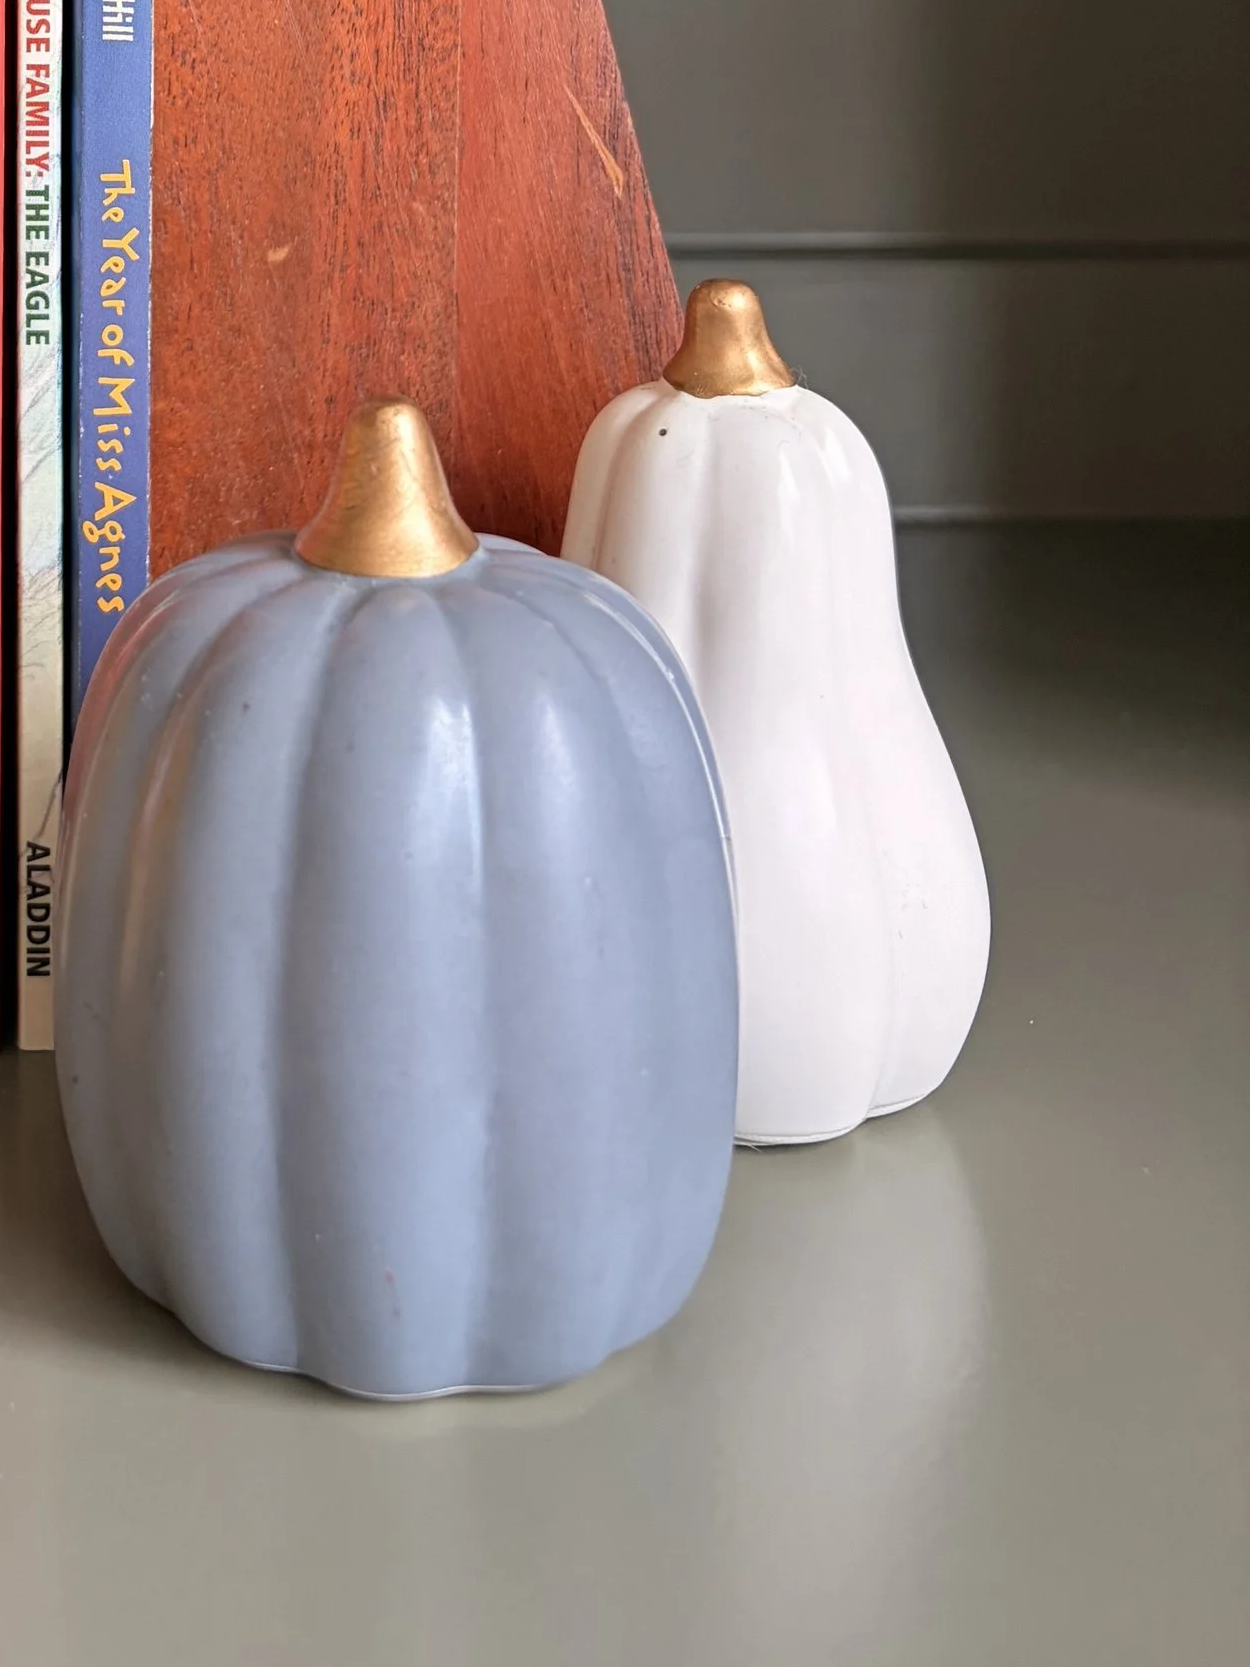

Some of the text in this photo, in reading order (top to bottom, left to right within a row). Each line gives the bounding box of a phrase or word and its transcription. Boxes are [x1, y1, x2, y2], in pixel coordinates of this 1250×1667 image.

[25, 63, 50, 178] FAMILY:
[25, 187, 50, 242] THE
[24, 251, 50, 345] EAGLE
[83, 160, 140, 613] The Year of Miss Agnes
[25, 841, 51, 977] ALADDIN
